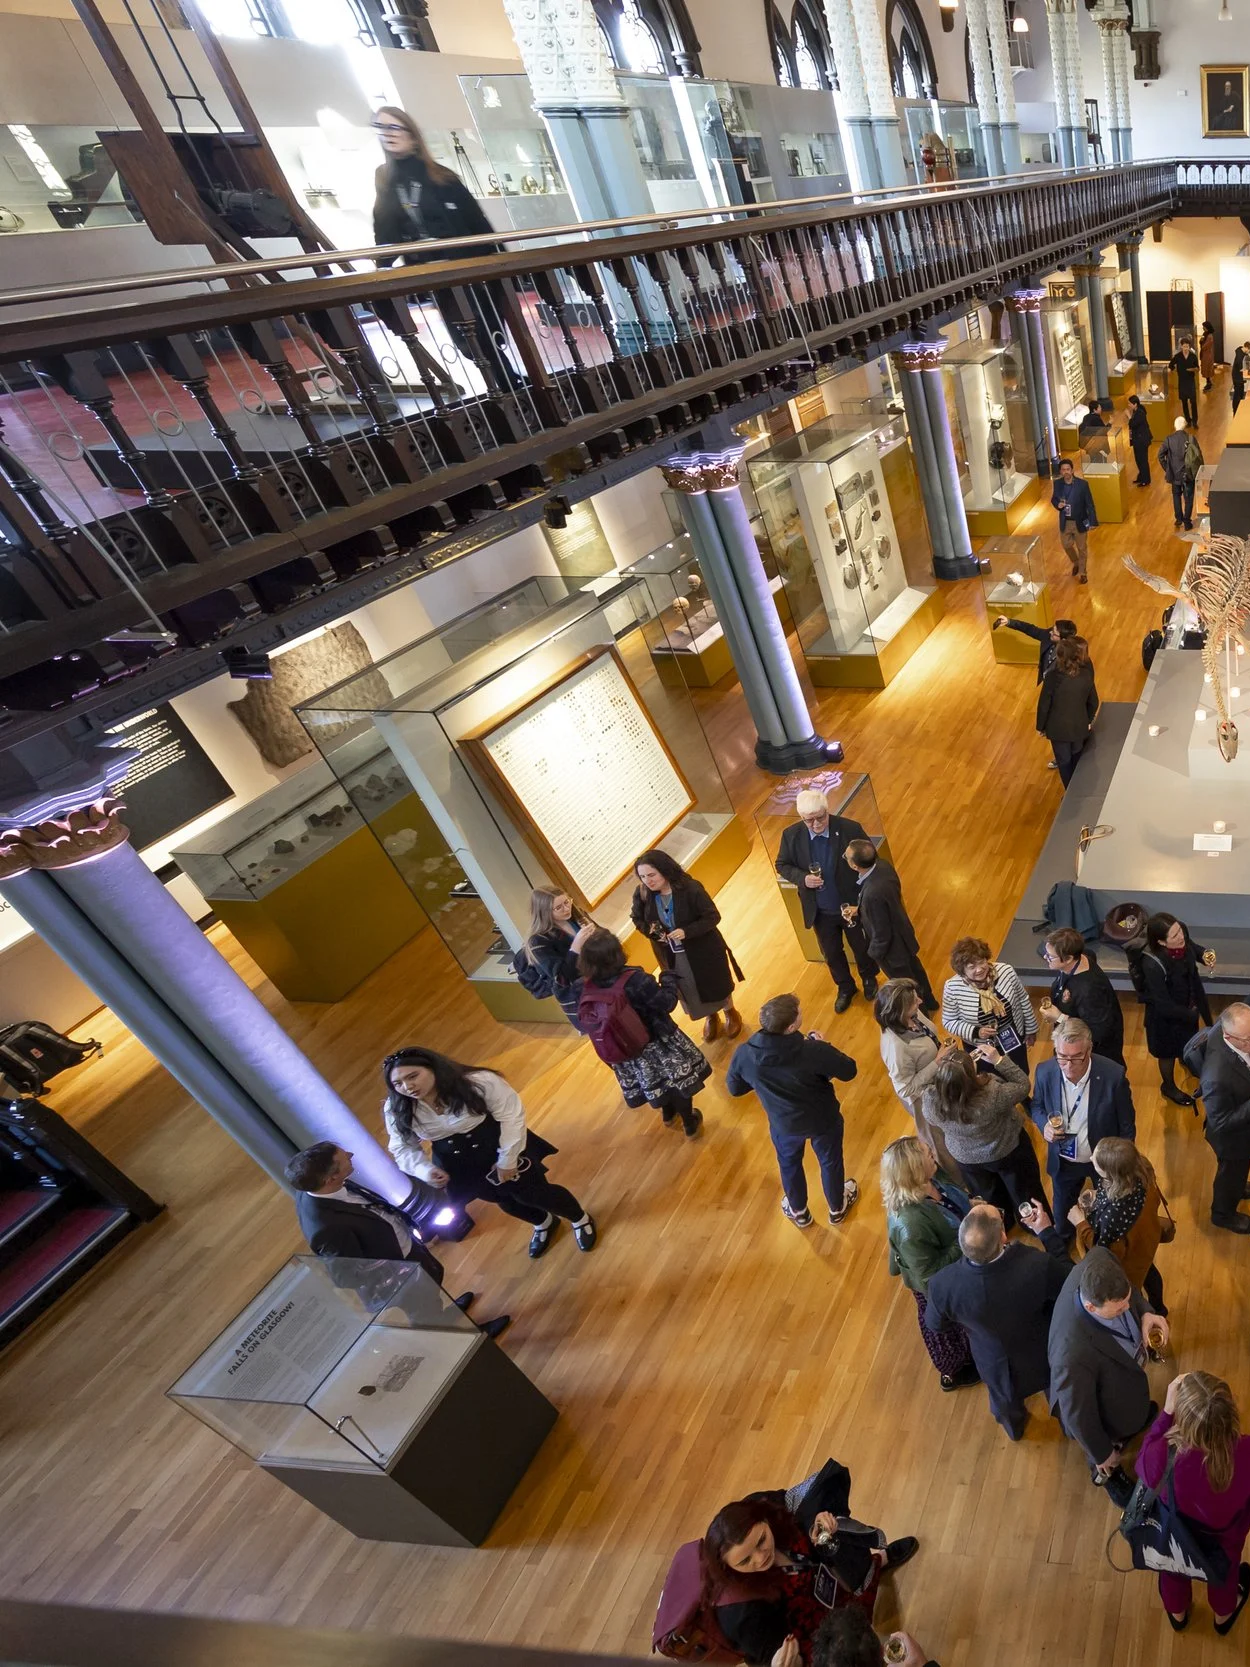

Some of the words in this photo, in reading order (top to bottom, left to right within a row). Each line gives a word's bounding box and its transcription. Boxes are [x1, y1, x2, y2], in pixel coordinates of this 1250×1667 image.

[228, 1353, 248, 1375] FALLS
[247, 1341, 261, 1353] ON
[259, 1301, 295, 1340] GLASGOW!
[241, 1309, 278, 1348] METEORITE
